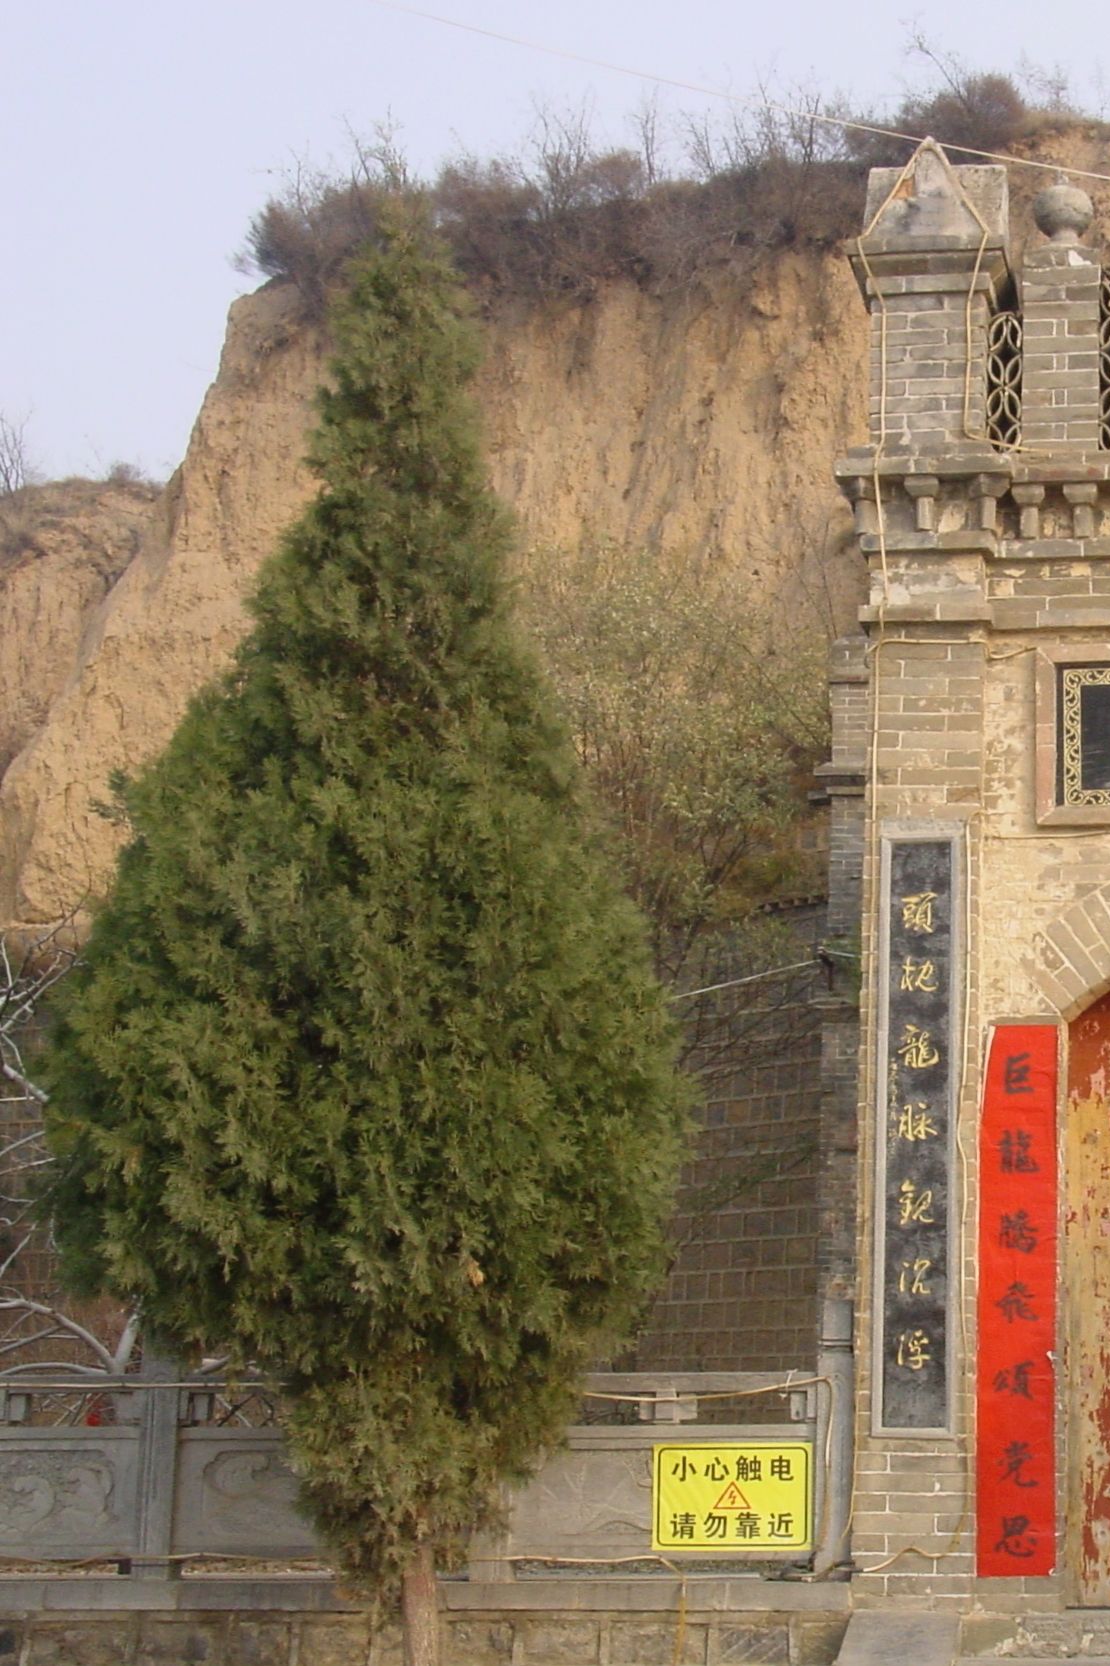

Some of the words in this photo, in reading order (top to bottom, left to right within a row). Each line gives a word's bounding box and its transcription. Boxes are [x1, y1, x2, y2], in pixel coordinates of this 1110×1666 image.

[671, 1455, 794, 1482] 小心触电
[670, 1511, 794, 1539] 请勿靠近
